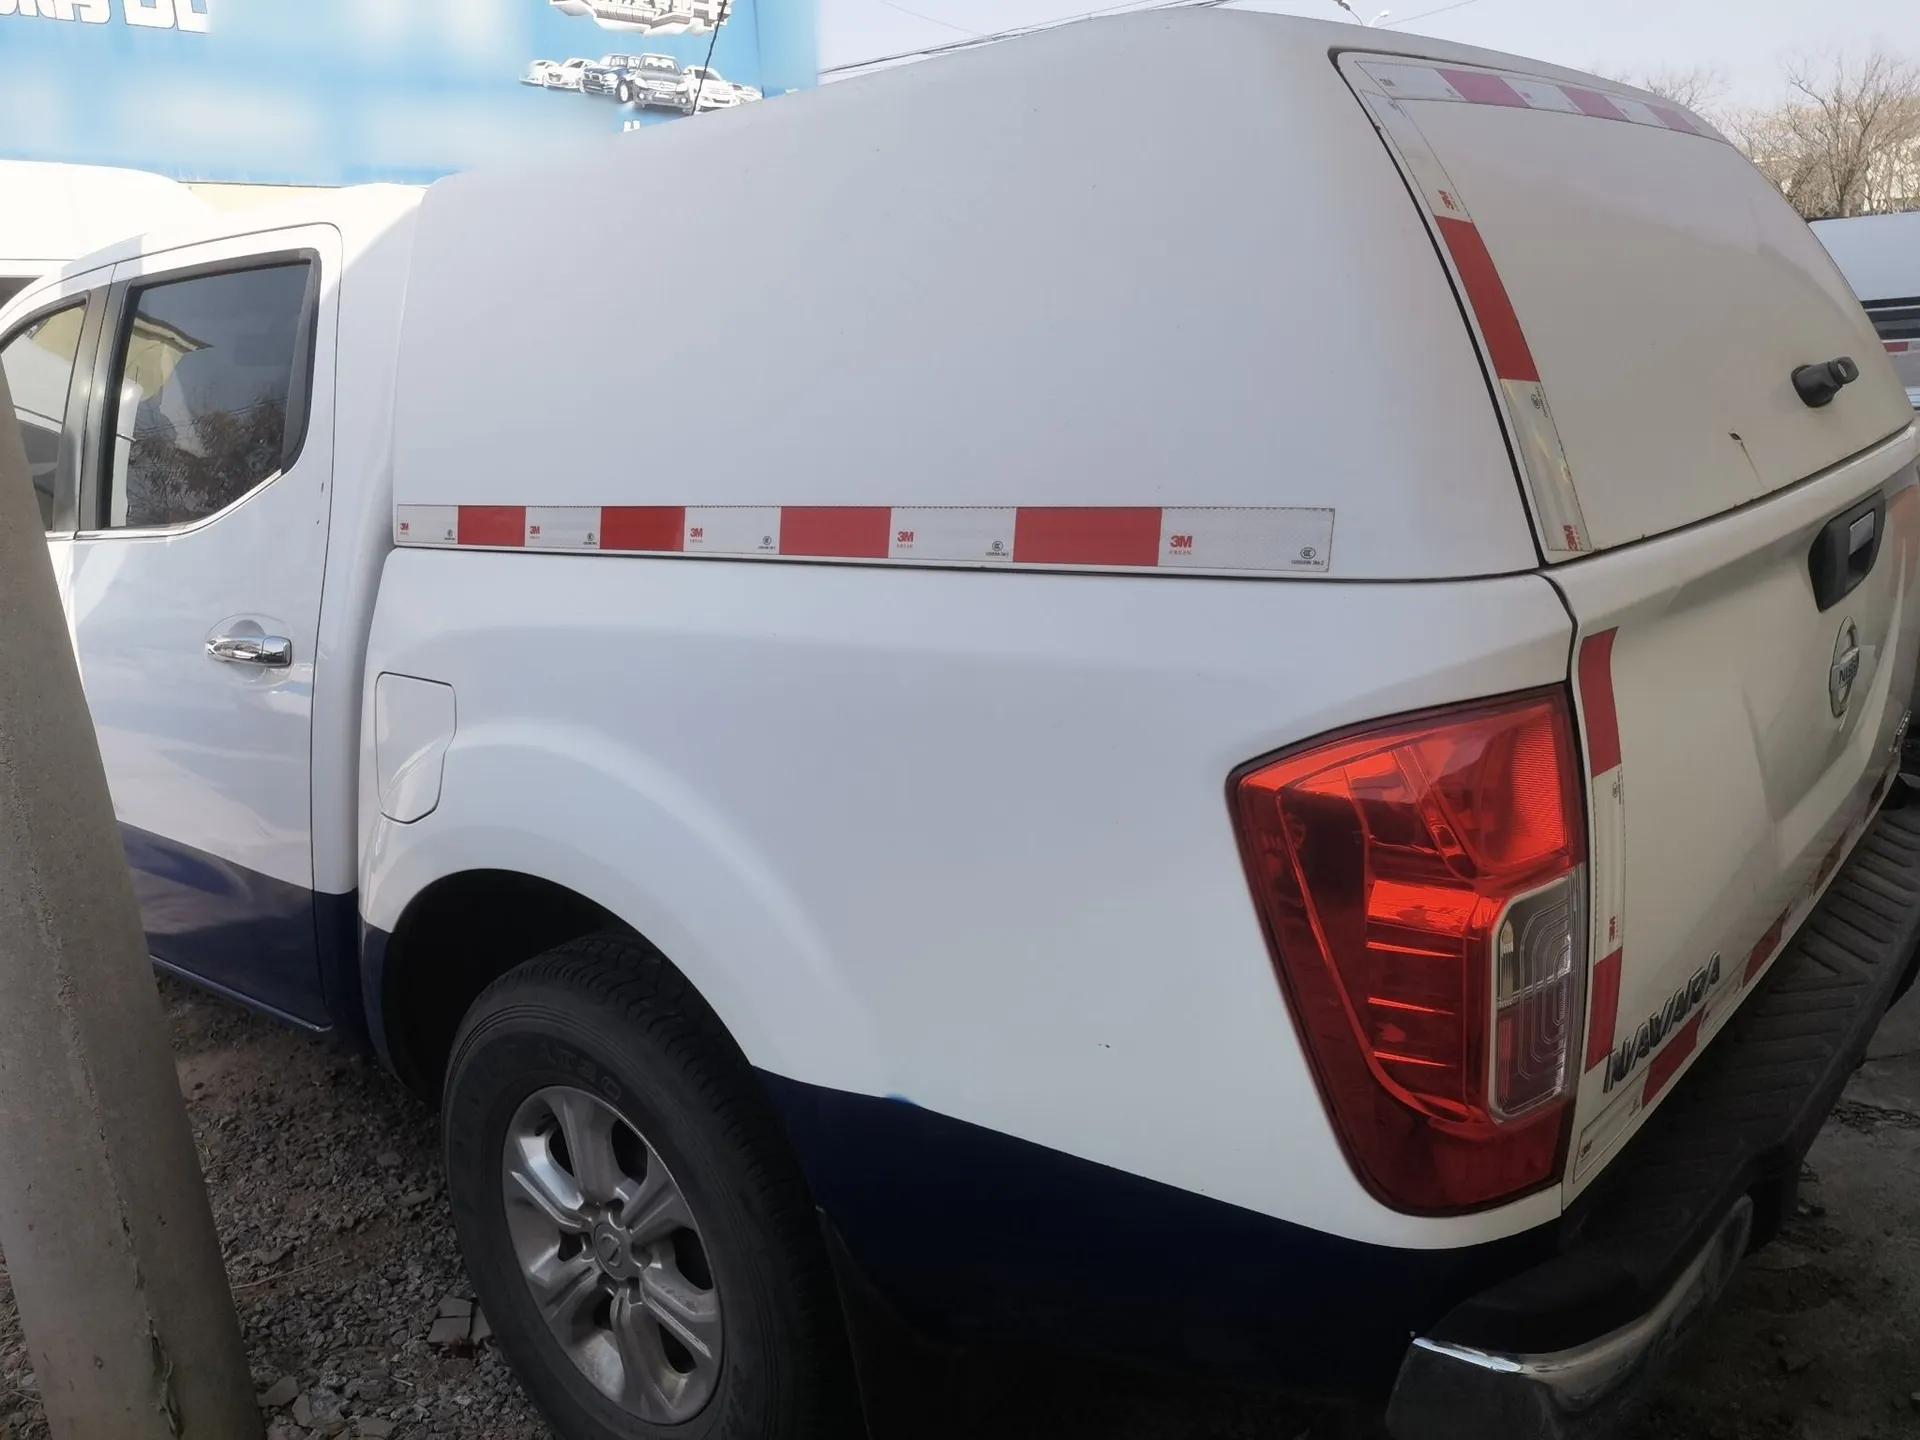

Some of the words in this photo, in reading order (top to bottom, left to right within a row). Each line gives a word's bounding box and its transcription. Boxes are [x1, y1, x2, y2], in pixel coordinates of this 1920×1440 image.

[399, 522, 410, 531] 3M
[529, 525, 541, 535] 3M
[689, 527, 704, 538] 3M
[896, 531, 915, 543] 3M
[1170, 535, 1193, 548] 3M
[1563, 525, 1578, 551] 3M
[1603, 951, 1721, 1094] NAVARA
